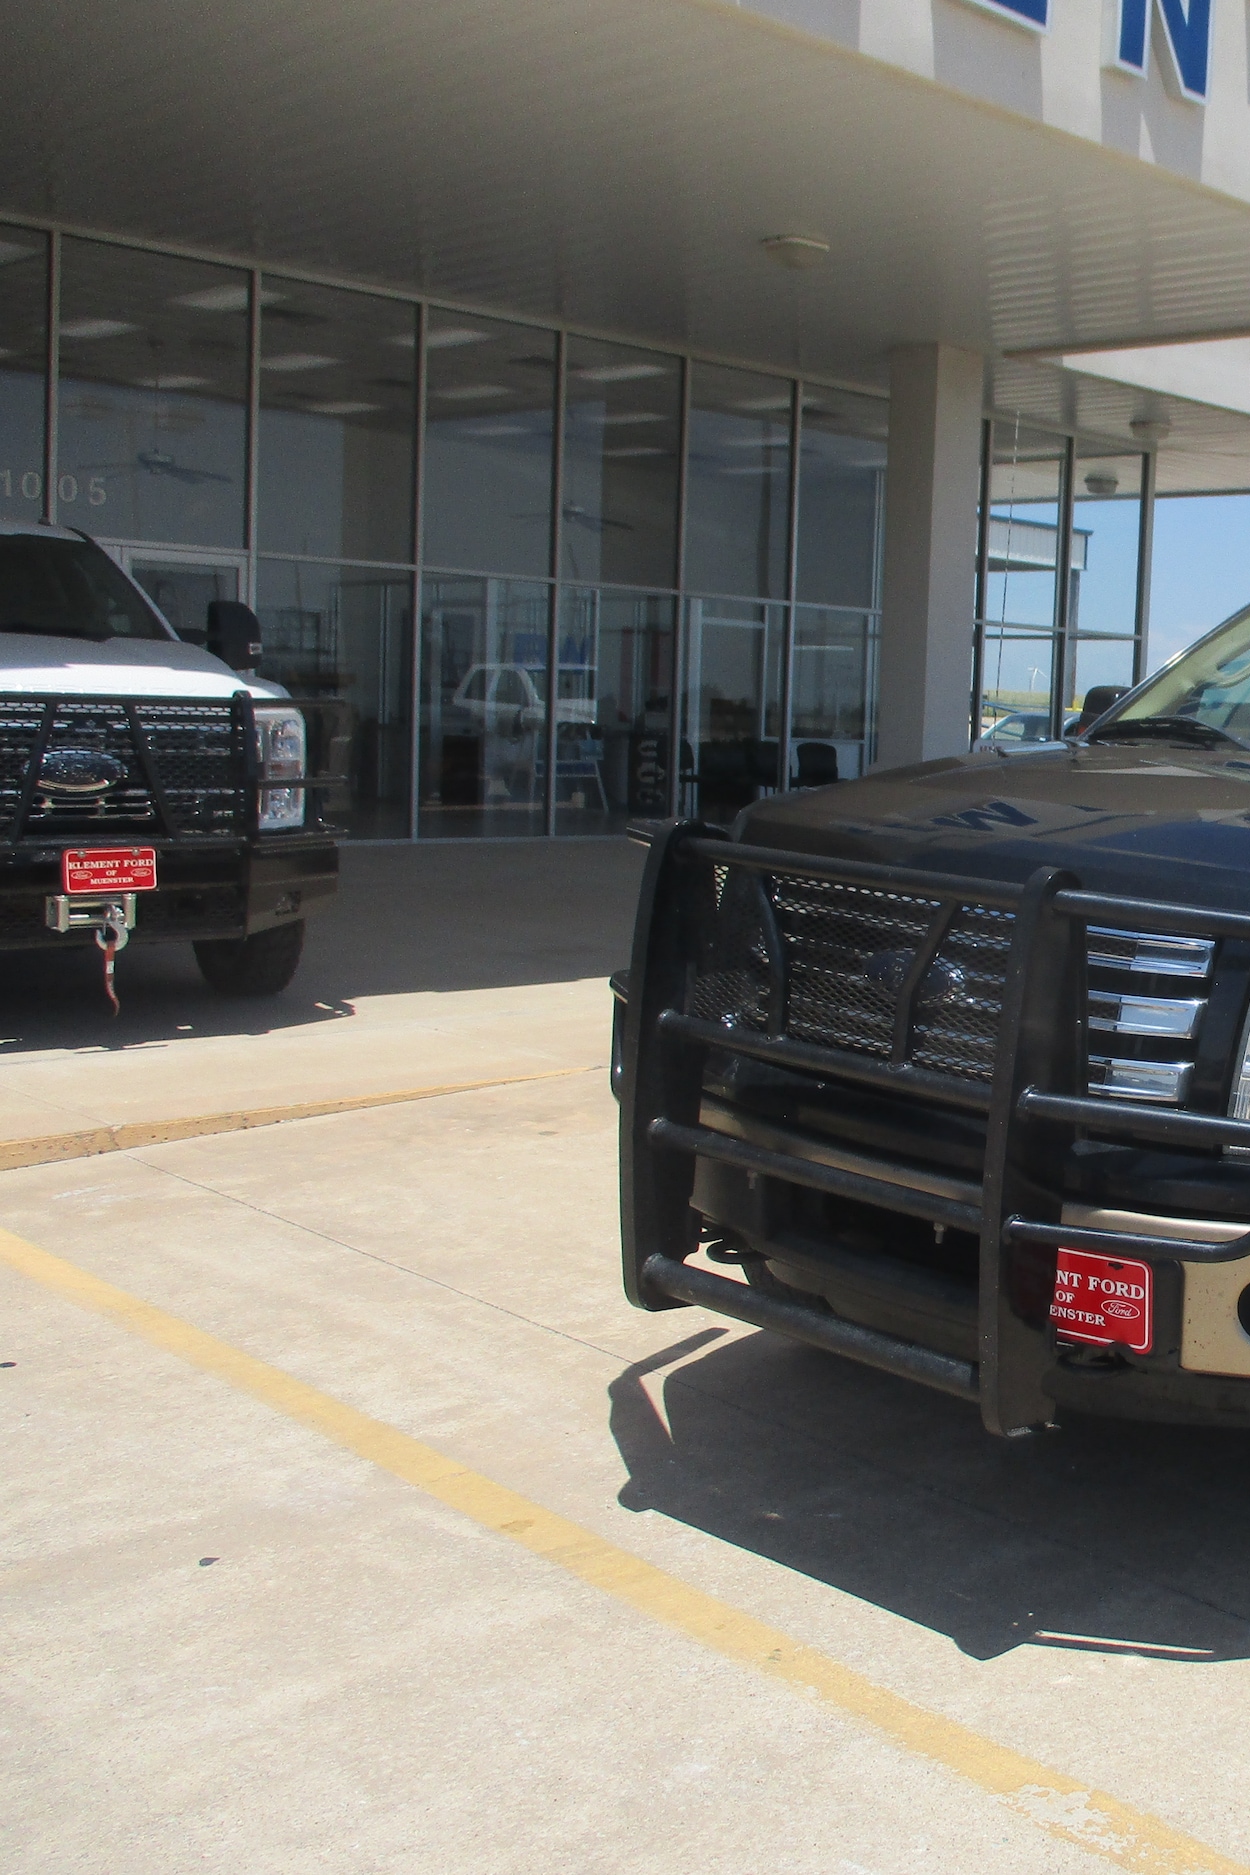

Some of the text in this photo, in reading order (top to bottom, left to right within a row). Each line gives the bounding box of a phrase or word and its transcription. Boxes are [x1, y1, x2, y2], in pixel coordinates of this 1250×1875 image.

[68, 859, 154, 870] KLEMENT FORD
[105, 869, 118, 877] OF
[90, 876, 134, 885] MUENSTER
[1087, 1275, 1145, 1300] FORD
[1055, 1289, 1076, 1304] OF
